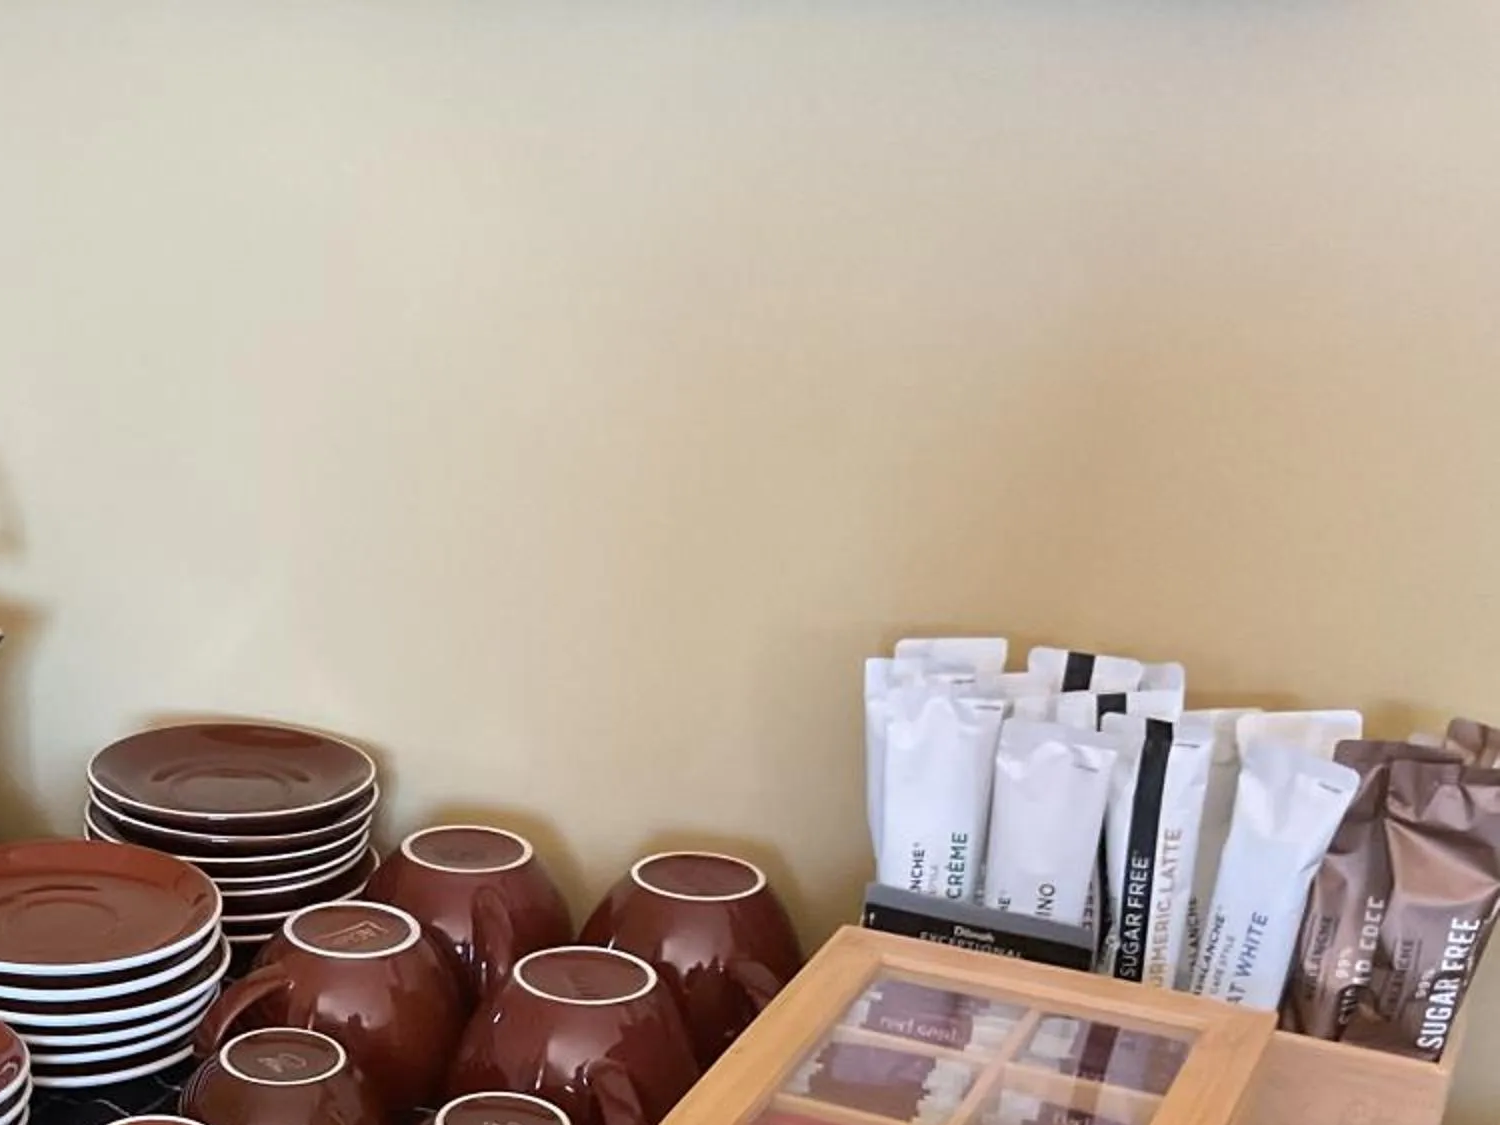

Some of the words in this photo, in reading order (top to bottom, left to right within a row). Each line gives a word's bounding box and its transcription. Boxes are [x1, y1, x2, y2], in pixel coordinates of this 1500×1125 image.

[1128, 856, 1149, 909] FREE
[1161, 828, 1182, 893] LATTE
[1120, 914, 1142, 977] SUGAR
[1234, 911, 1269, 976] WHITE
[1416, 977, 1461, 1050] SUGAR
[1441, 917, 1480, 972] FREE
